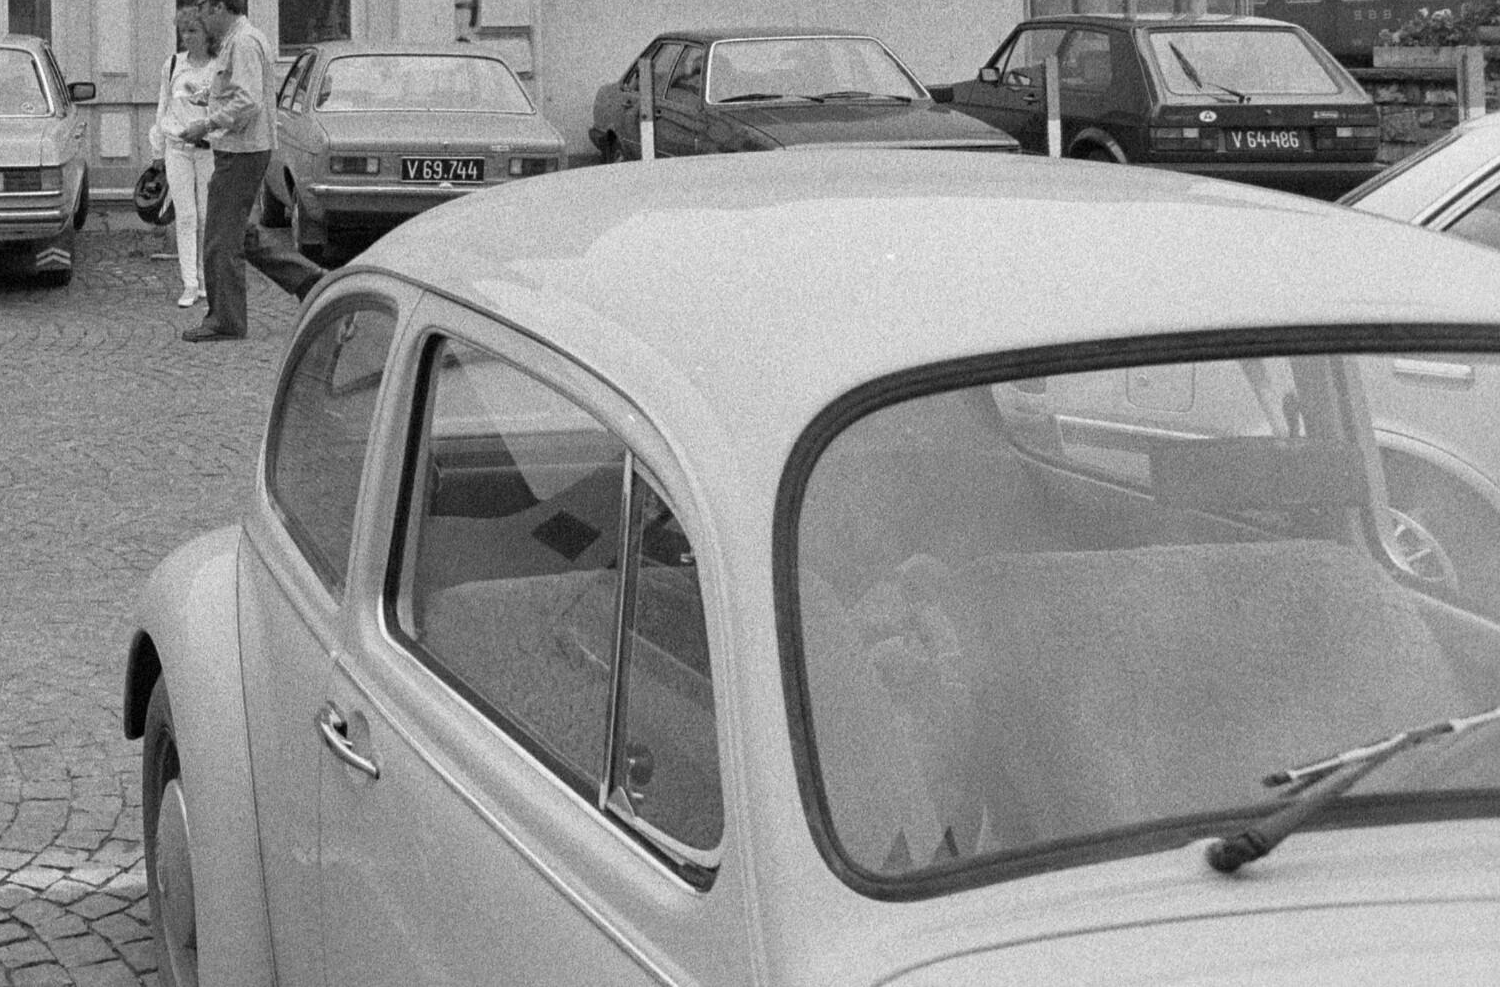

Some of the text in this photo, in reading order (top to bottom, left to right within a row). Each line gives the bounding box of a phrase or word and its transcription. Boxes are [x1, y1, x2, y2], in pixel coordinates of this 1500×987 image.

[1231, 131, 1299, 148] V 64.486
[407, 160, 478, 180] V 69.744
